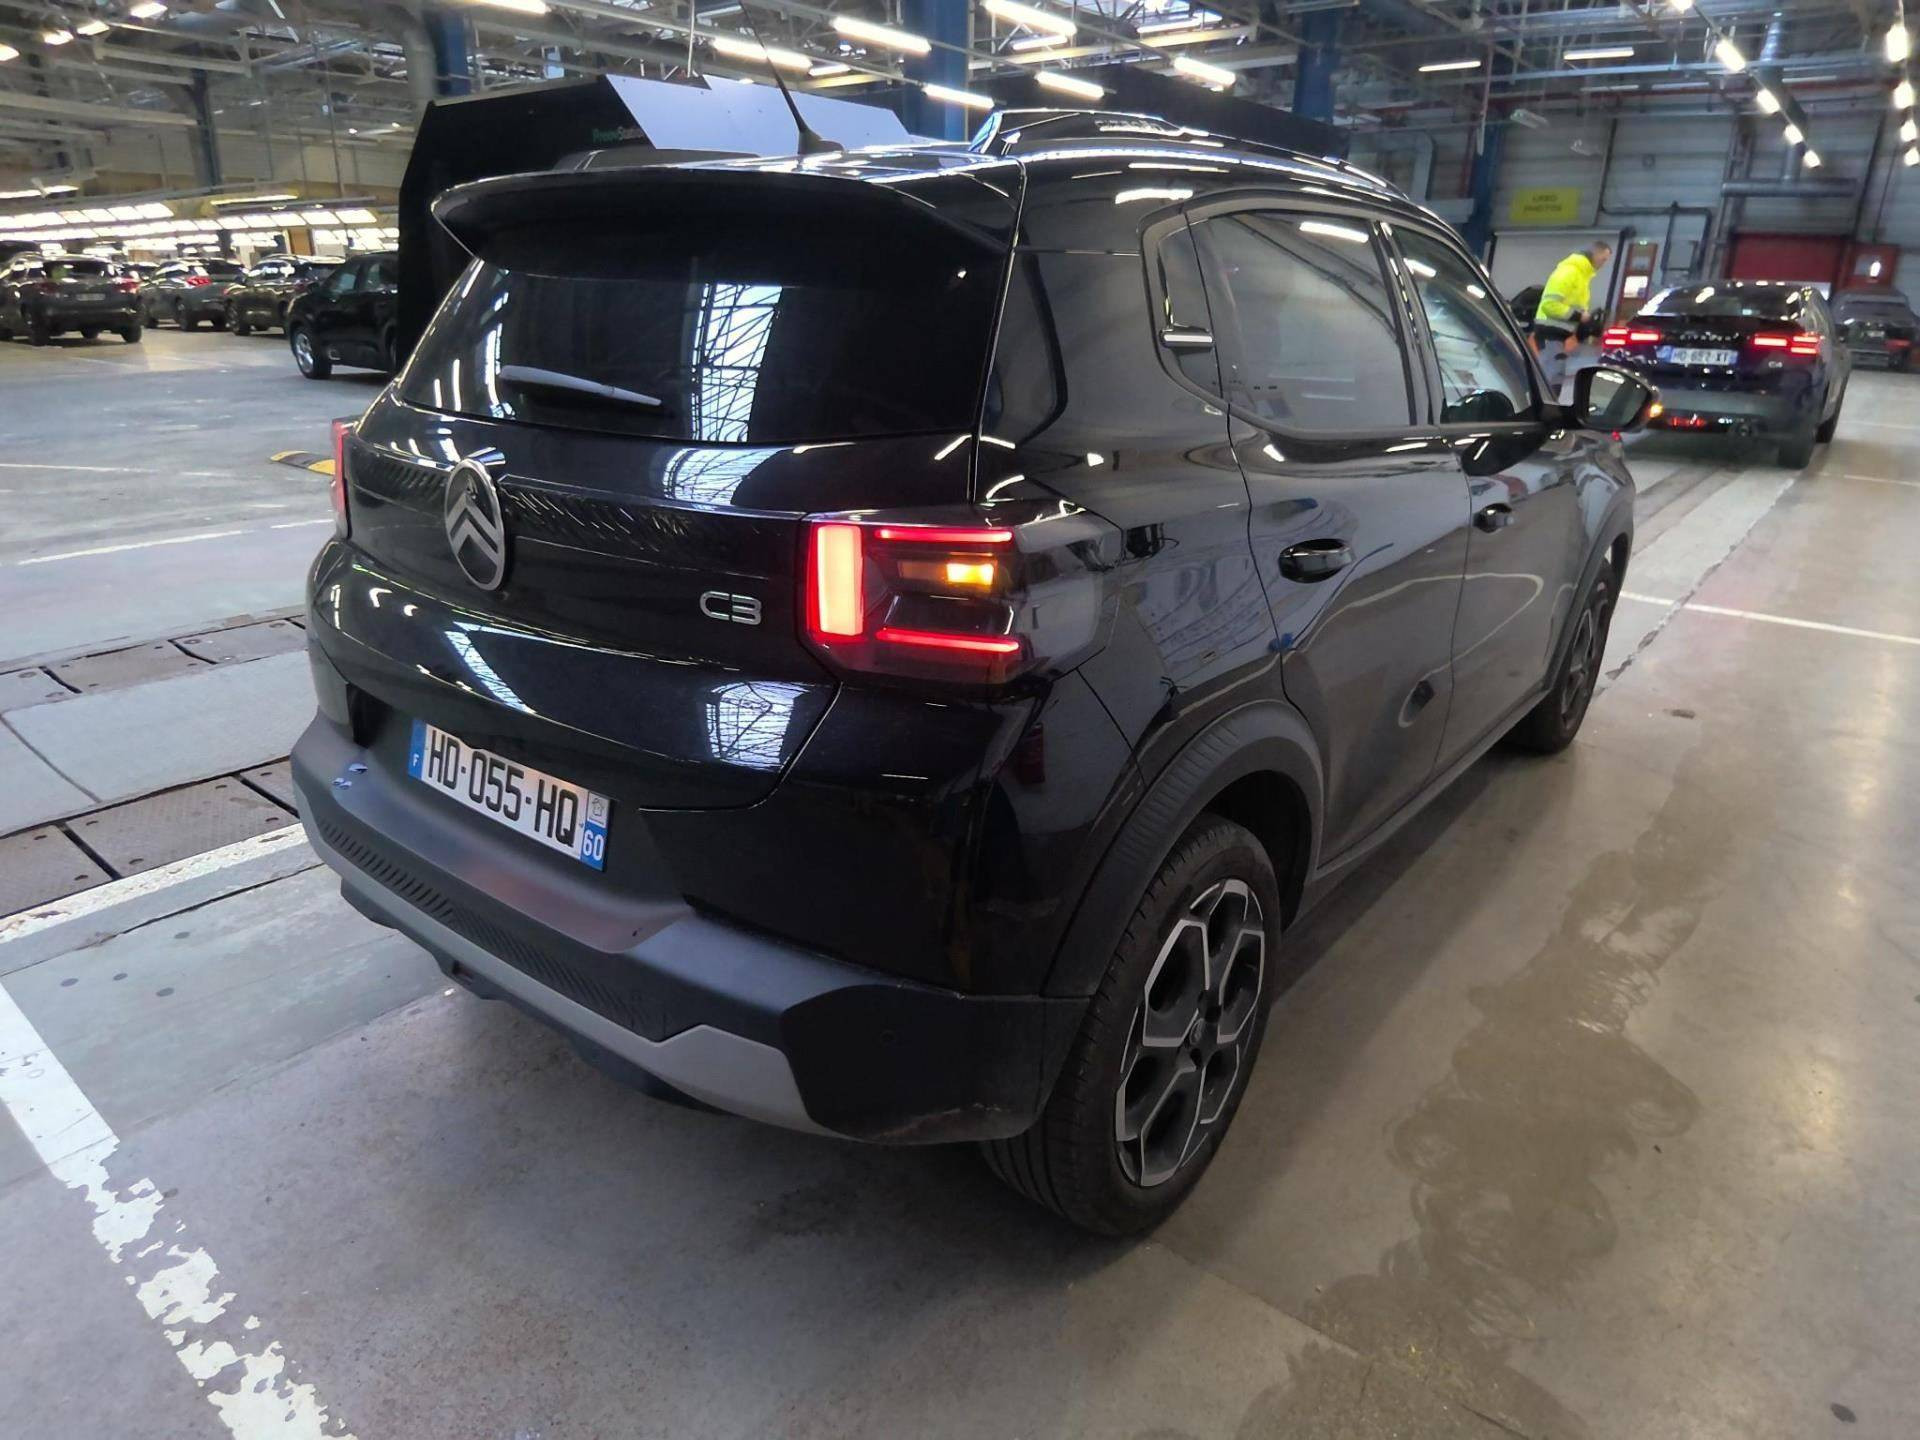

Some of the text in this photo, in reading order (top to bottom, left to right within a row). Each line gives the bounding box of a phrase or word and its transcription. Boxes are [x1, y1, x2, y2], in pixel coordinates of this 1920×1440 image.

[699, 590, 762, 626] C3
[413, 753, 420, 767] F
[428, 729, 579, 848] HD-055-HQ
[582, 829, 605, 861] 60
